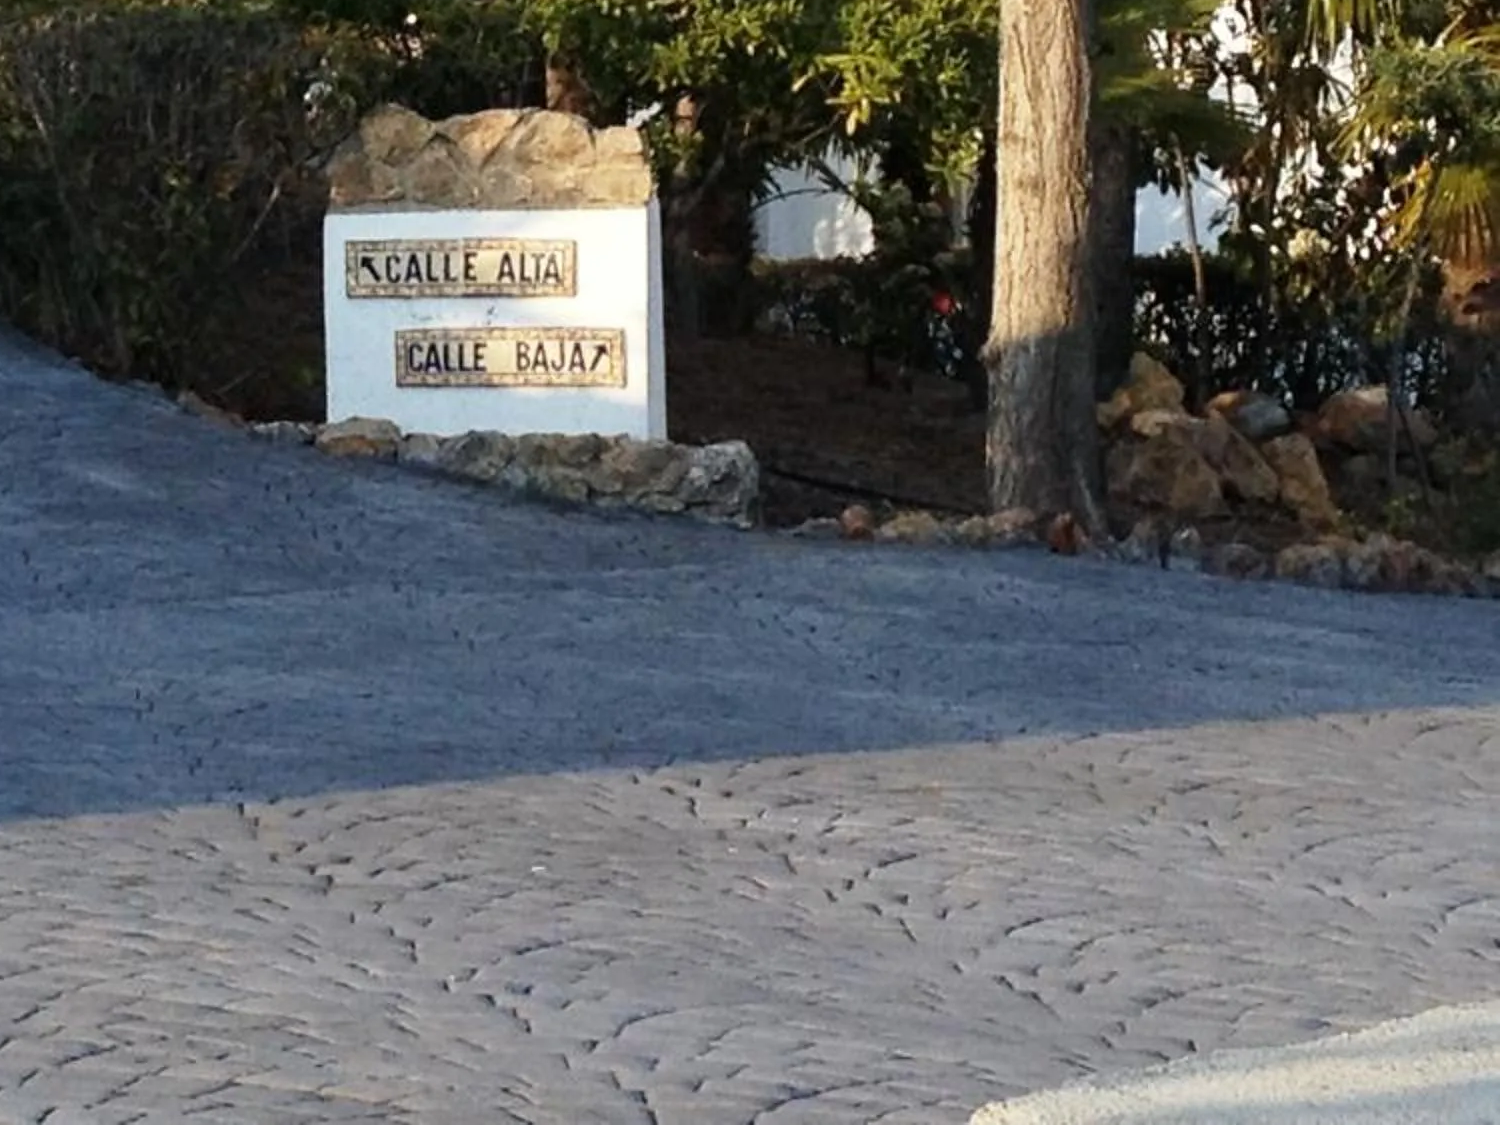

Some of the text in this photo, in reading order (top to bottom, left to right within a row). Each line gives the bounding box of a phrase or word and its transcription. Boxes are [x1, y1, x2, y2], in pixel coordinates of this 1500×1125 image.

[385, 251, 562, 284] CALLE ALTA
[408, 342, 585, 372] CALLE BAJA
